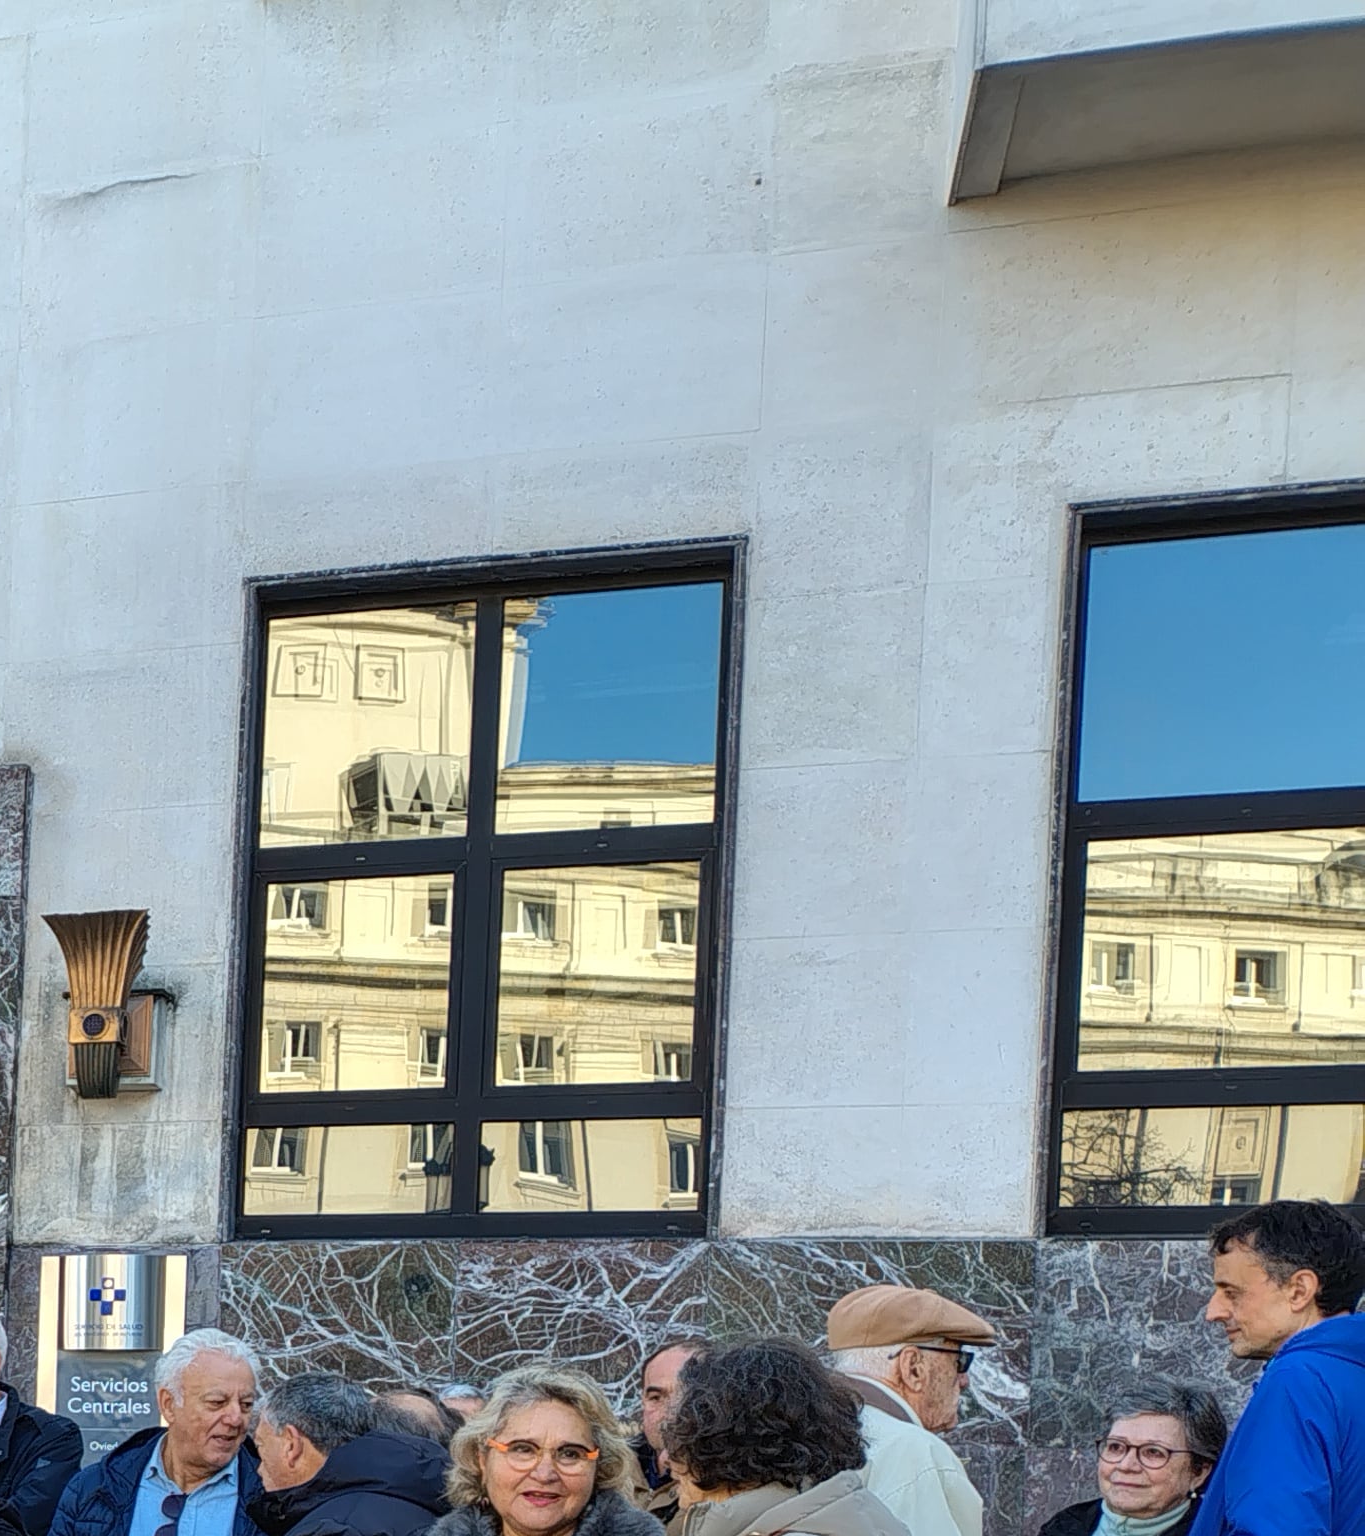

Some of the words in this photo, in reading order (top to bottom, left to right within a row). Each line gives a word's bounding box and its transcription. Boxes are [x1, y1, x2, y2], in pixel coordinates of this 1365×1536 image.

[70, 1376, 148, 1393] Servicios
[67, 1397, 151, 1414] Centrales
[89, 1440, 119, 1452] Ovied
